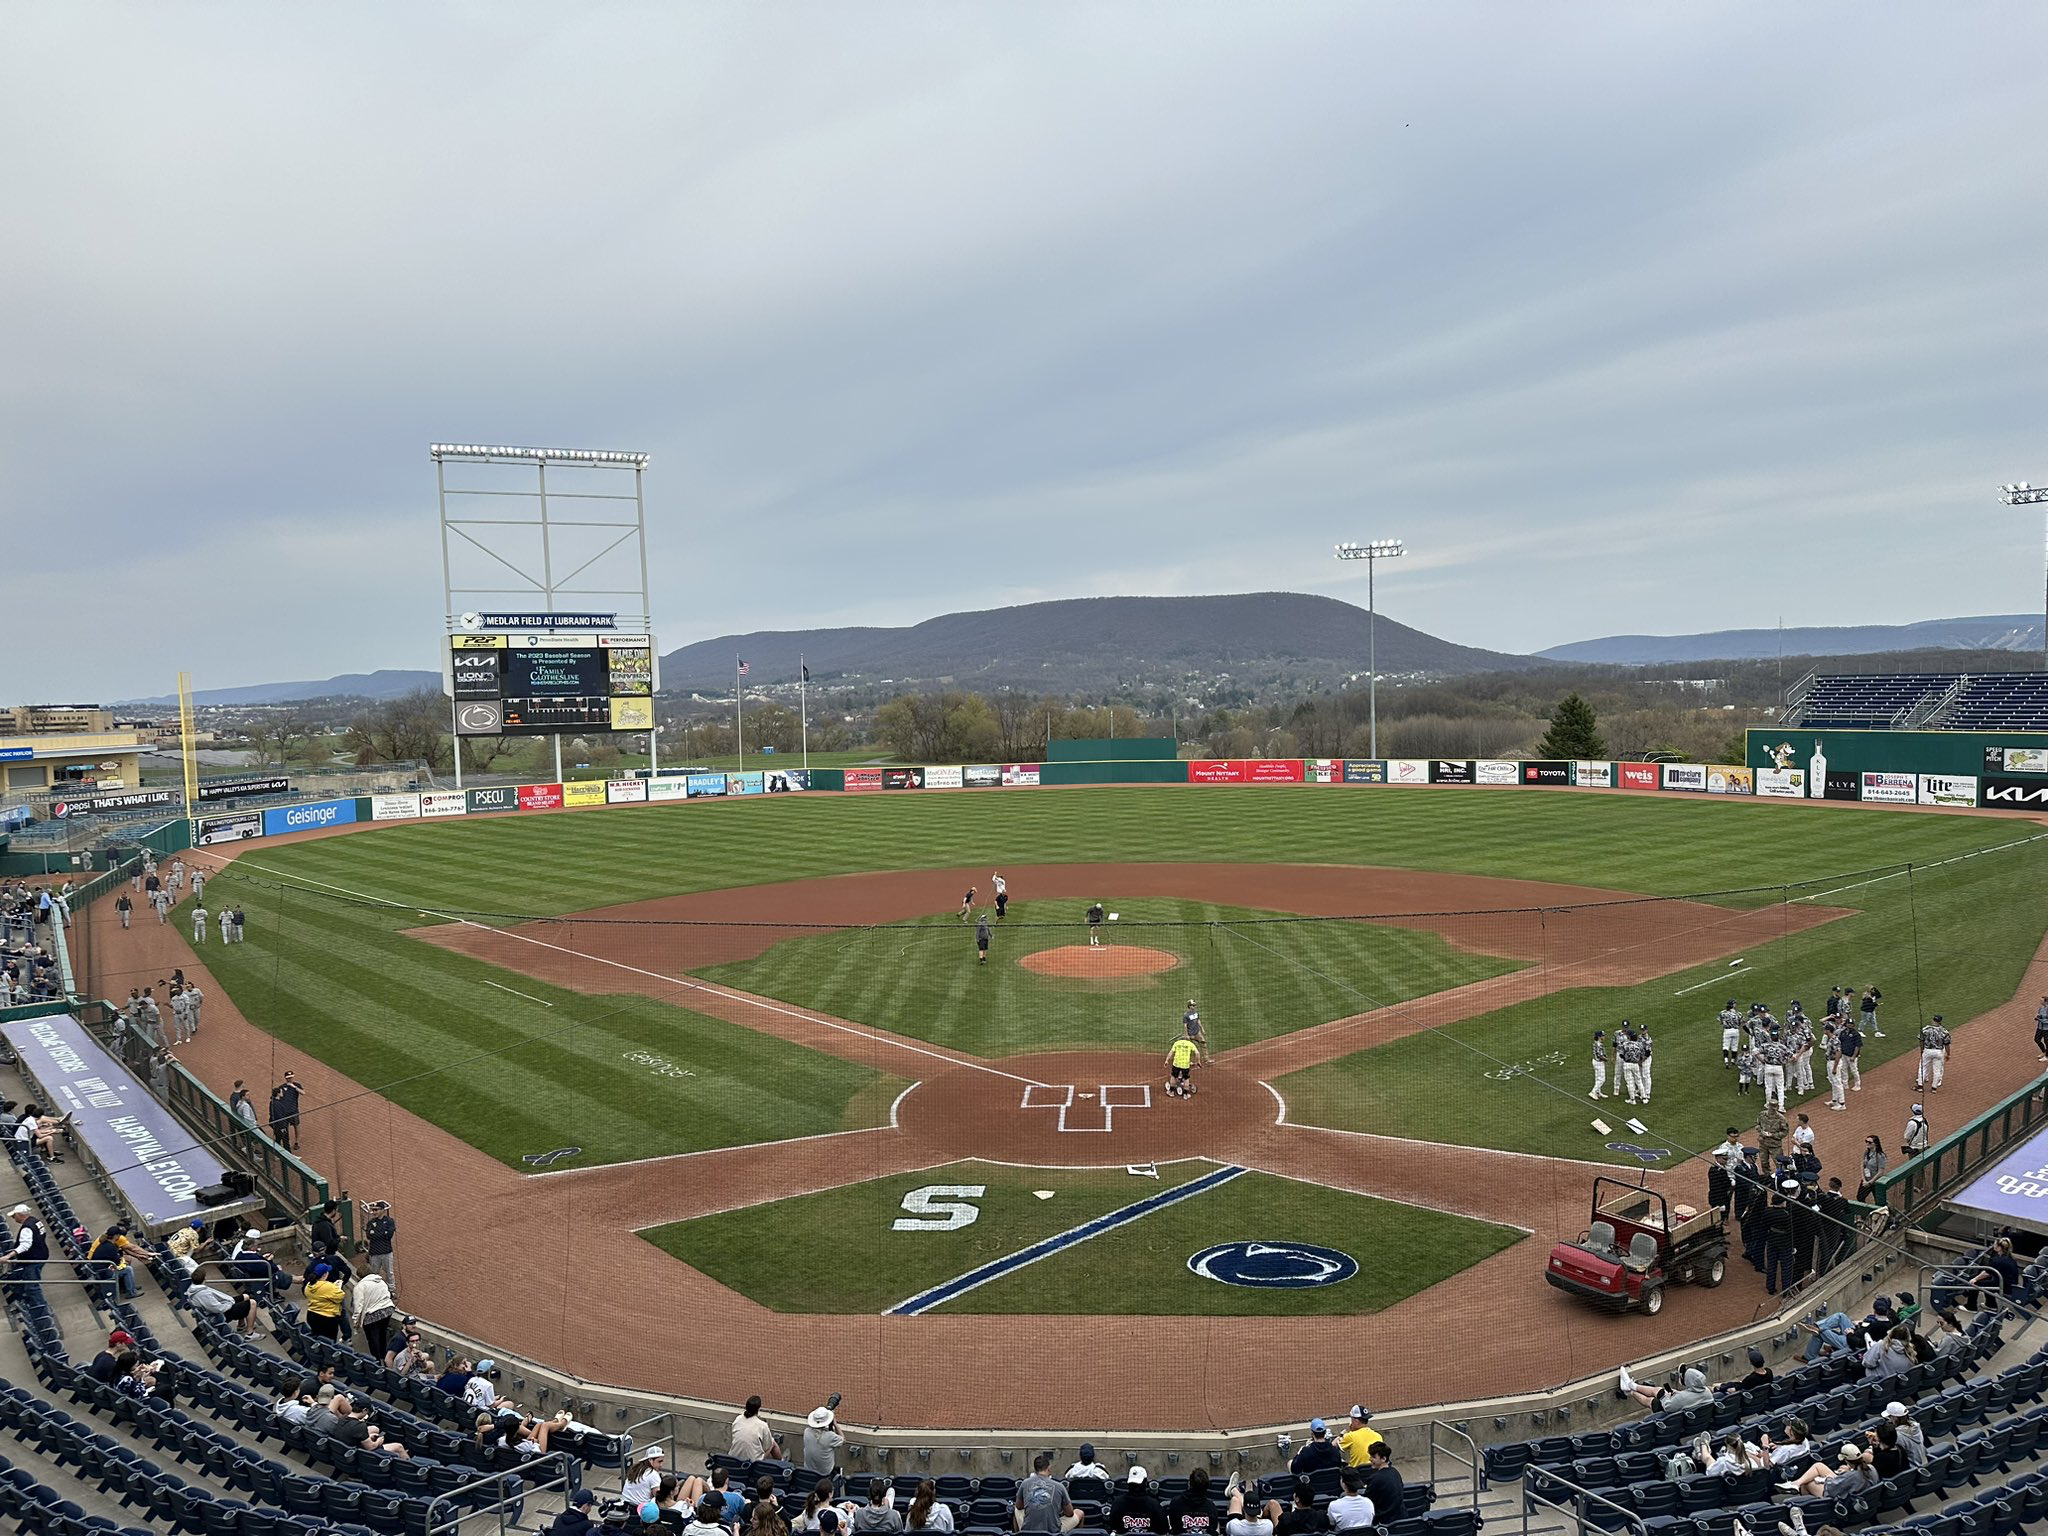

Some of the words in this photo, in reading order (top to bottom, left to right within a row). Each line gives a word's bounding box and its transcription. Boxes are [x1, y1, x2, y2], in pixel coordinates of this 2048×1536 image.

[486, 616, 520, 626] MEDLAR
[521, 616, 542, 625] FIELD
[543, 616, 553, 625] AT
[555, 616, 590, 625] LUBRANO
[591, 616, 611, 625] PARK
[464, 636, 497, 644] P2P
[455, 657, 495, 666] KIA
[1625, 769, 1653, 780] weis
[1680, 776, 1701, 784] company
[1791, 775, 1801, 783] 811
[1876, 774, 1913, 786] BERRENA
[688, 777, 724, 787] BRADLEY'S
[1828, 781, 1856, 789] KLYR
[1926, 779, 1952, 794] Lite
[68, 801, 91, 813] pepsi
[93, 797, 122, 808] THAT'S
[123, 795, 147, 806] WHAT
[152, 793, 169, 802] LIKE
[475, 790, 504, 804] PSECU
[287, 806, 337, 825] Geisinger
[26, 1022, 66, 1048] WELCOME
[892, 1185, 987, 1231] S
[1122, 1515, 1150, 1529] PMAN
[1182, 1514, 1210, 1529] PMAN
